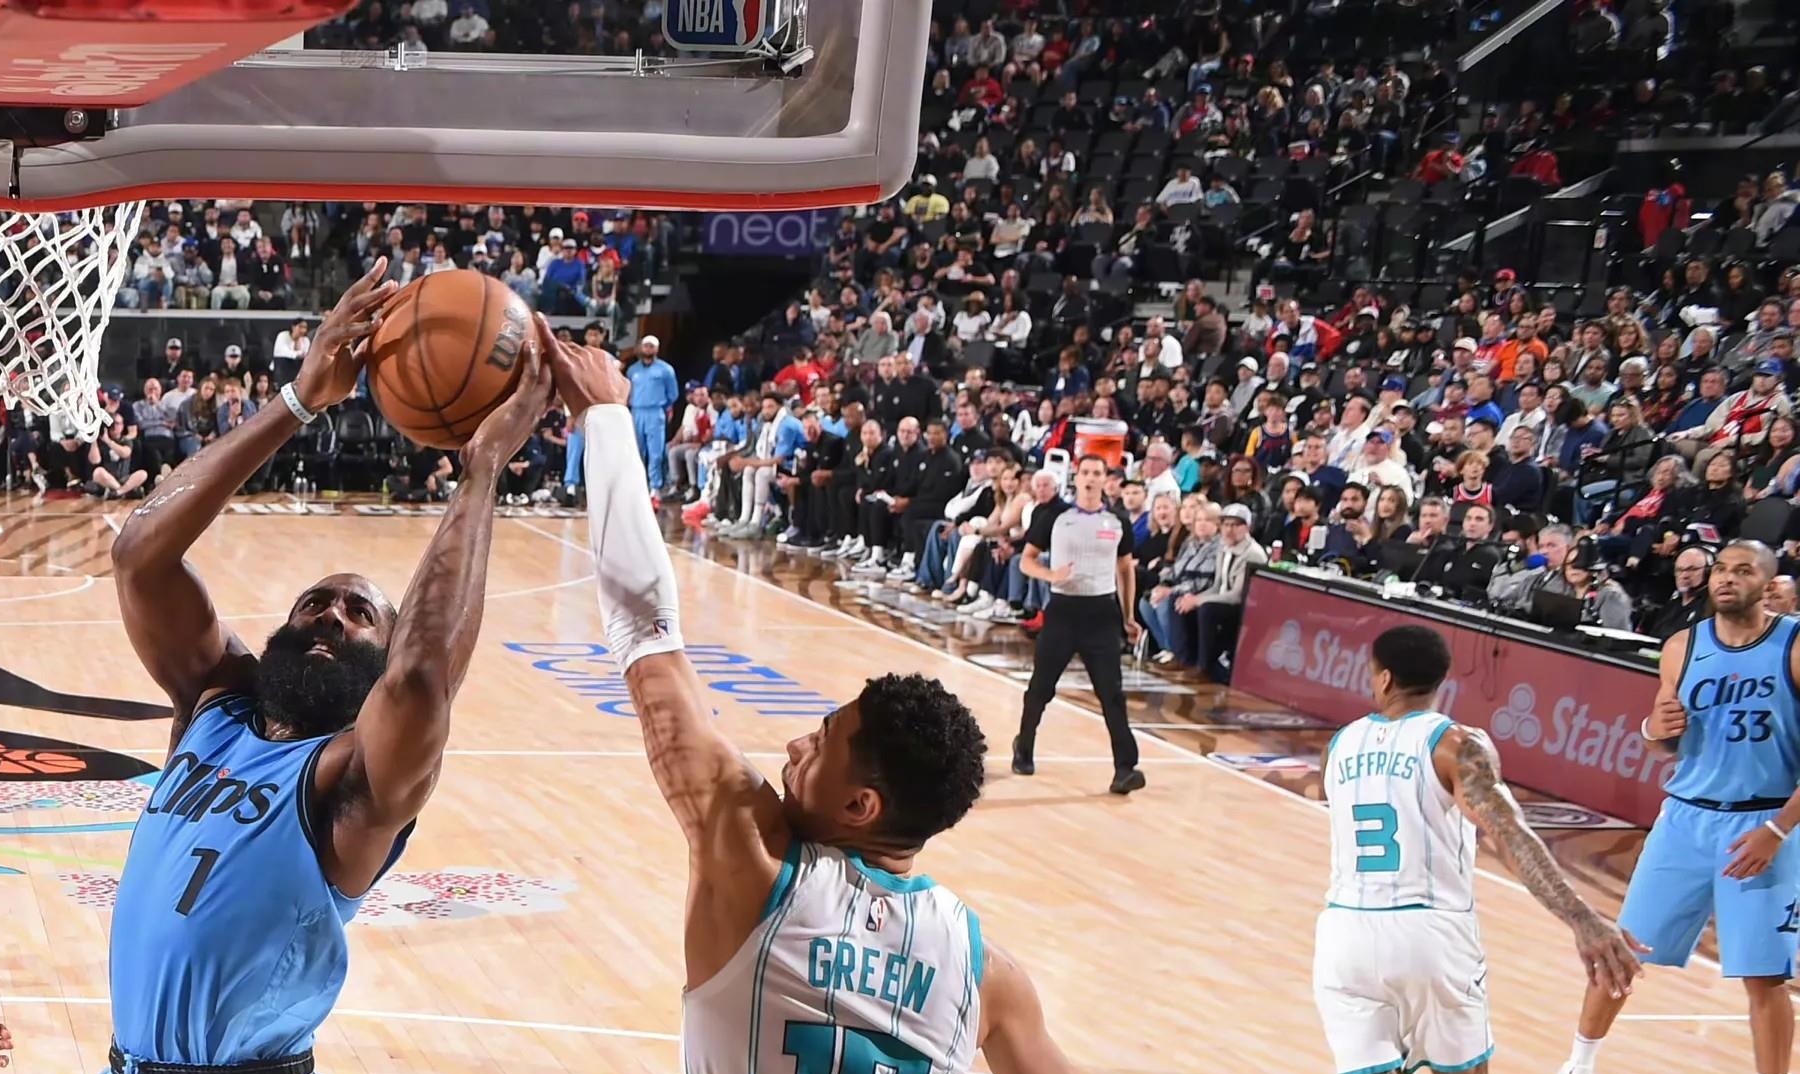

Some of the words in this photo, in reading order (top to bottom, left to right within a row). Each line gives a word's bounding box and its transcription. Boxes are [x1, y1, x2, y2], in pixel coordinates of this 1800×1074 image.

[677, 0, 724, 33] NBA
[1689, 672, 1776, 712] Clips
[1726, 709, 1772, 743] 33
[147, 751, 280, 825] Clips
[1338, 751, 1418, 785] JEFFRIES
[1351, 802, 1401, 873] 3
[174, 847, 221, 917] 1
[807, 936, 936, 1014] GREEN
